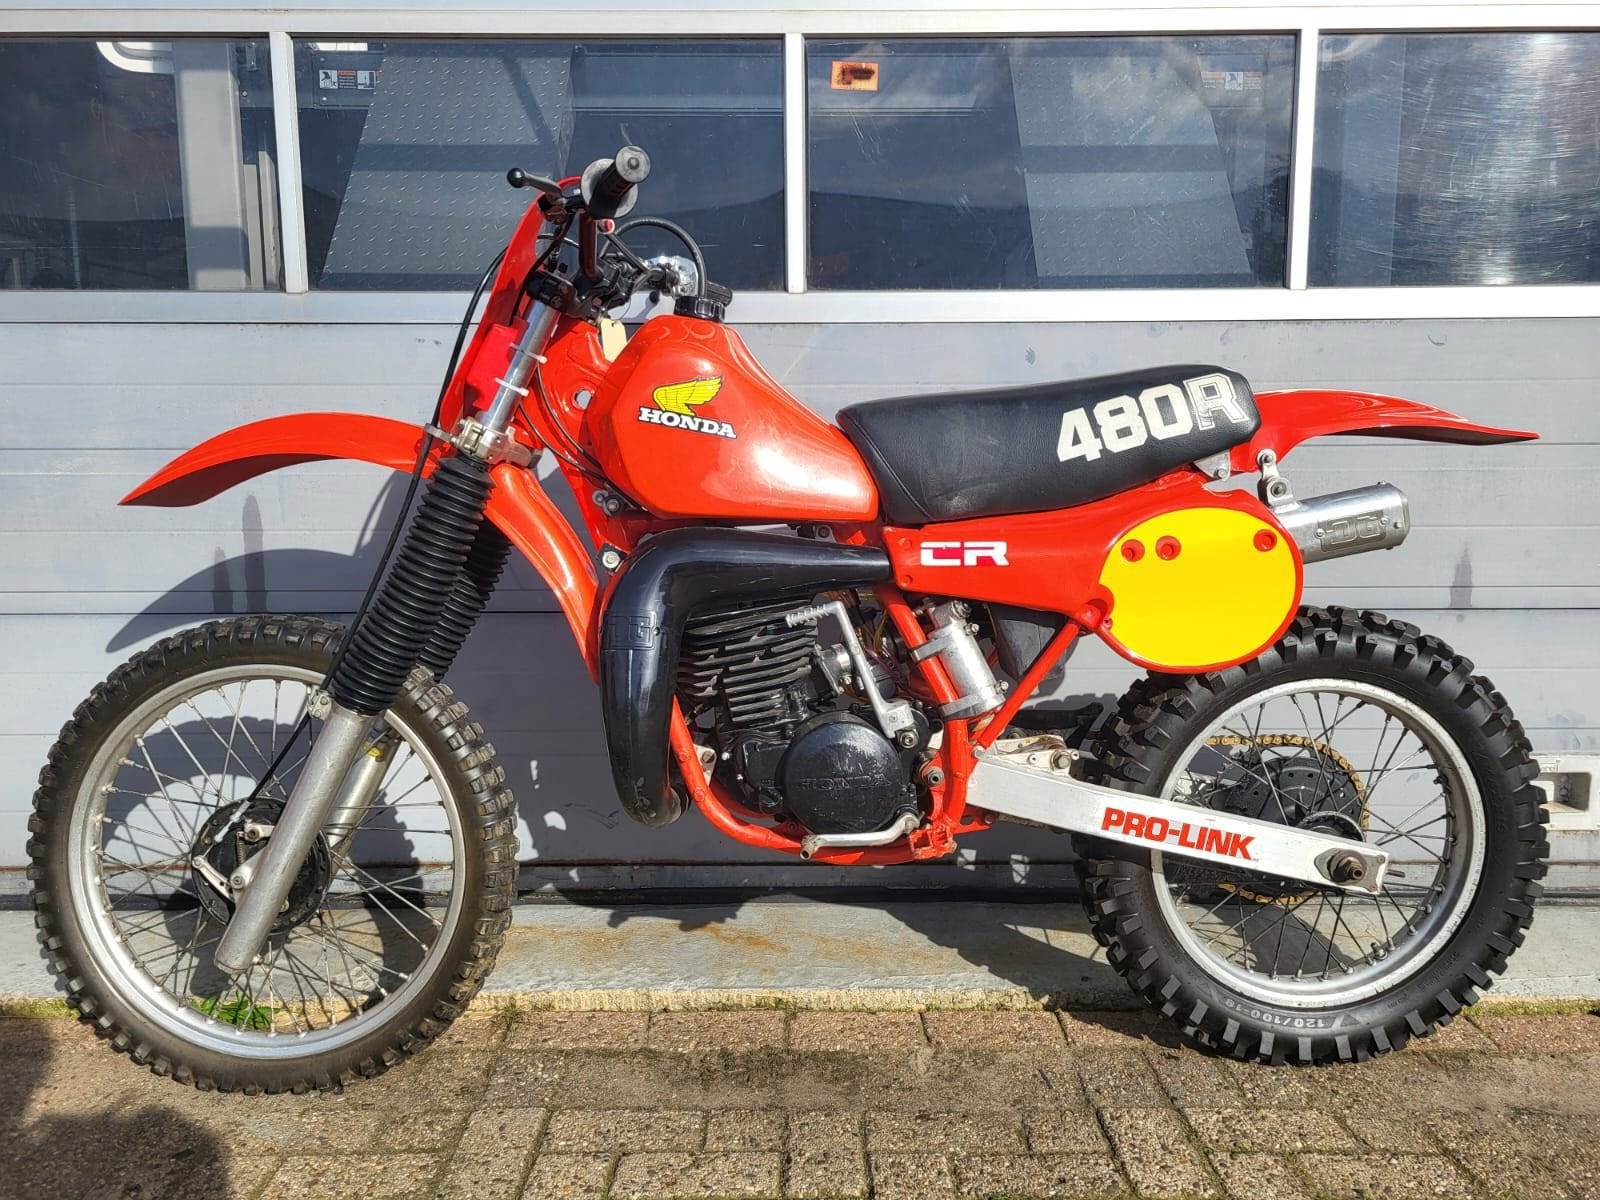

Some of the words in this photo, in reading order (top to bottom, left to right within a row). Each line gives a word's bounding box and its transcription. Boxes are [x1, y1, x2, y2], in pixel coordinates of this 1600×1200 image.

[638, 407, 737, 439] HONDA
[1056, 372, 1250, 463] 480R
[920, 541, 1010, 567] CR
[1101, 806, 1255, 861] PRO-LINK
